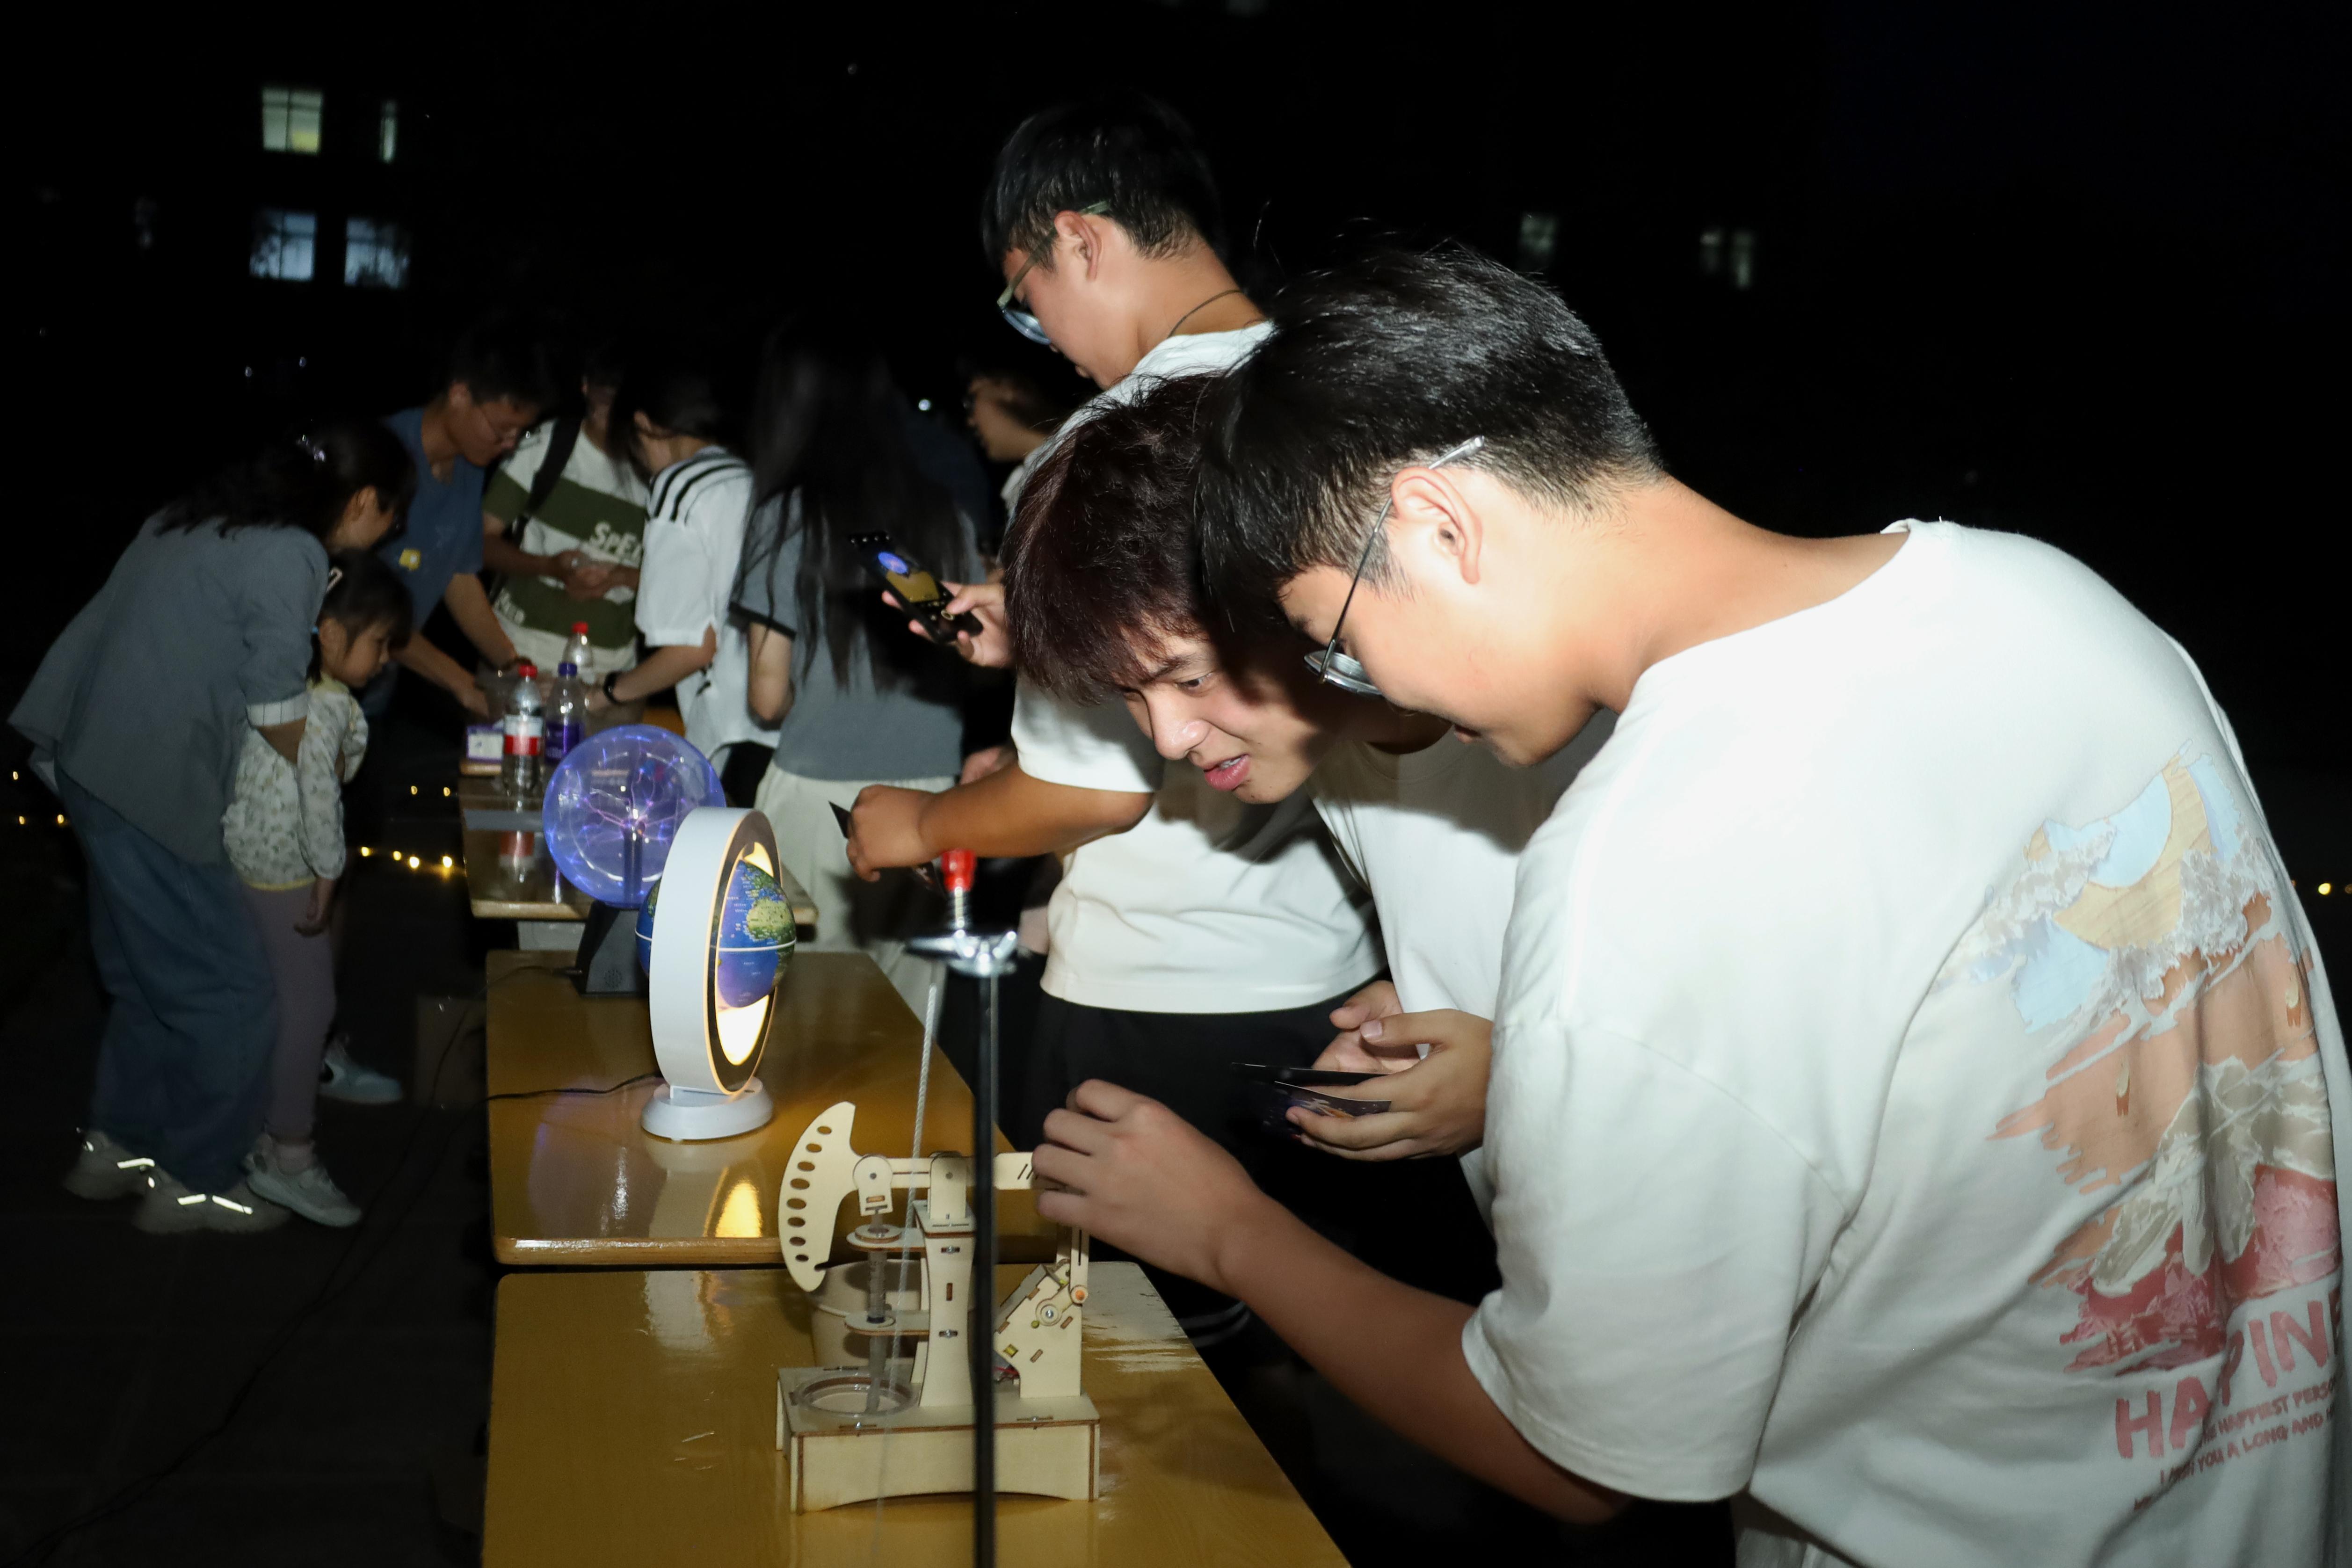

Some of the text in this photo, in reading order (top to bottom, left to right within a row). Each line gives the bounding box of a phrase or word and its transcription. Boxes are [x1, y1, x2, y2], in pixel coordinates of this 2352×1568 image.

[2198, 1449, 2224, 1473] YOU
[2227, 1441, 2240, 1459] A
[2242, 1425, 2288, 1453] LONG
[2292, 1411, 2324, 1435] AND
